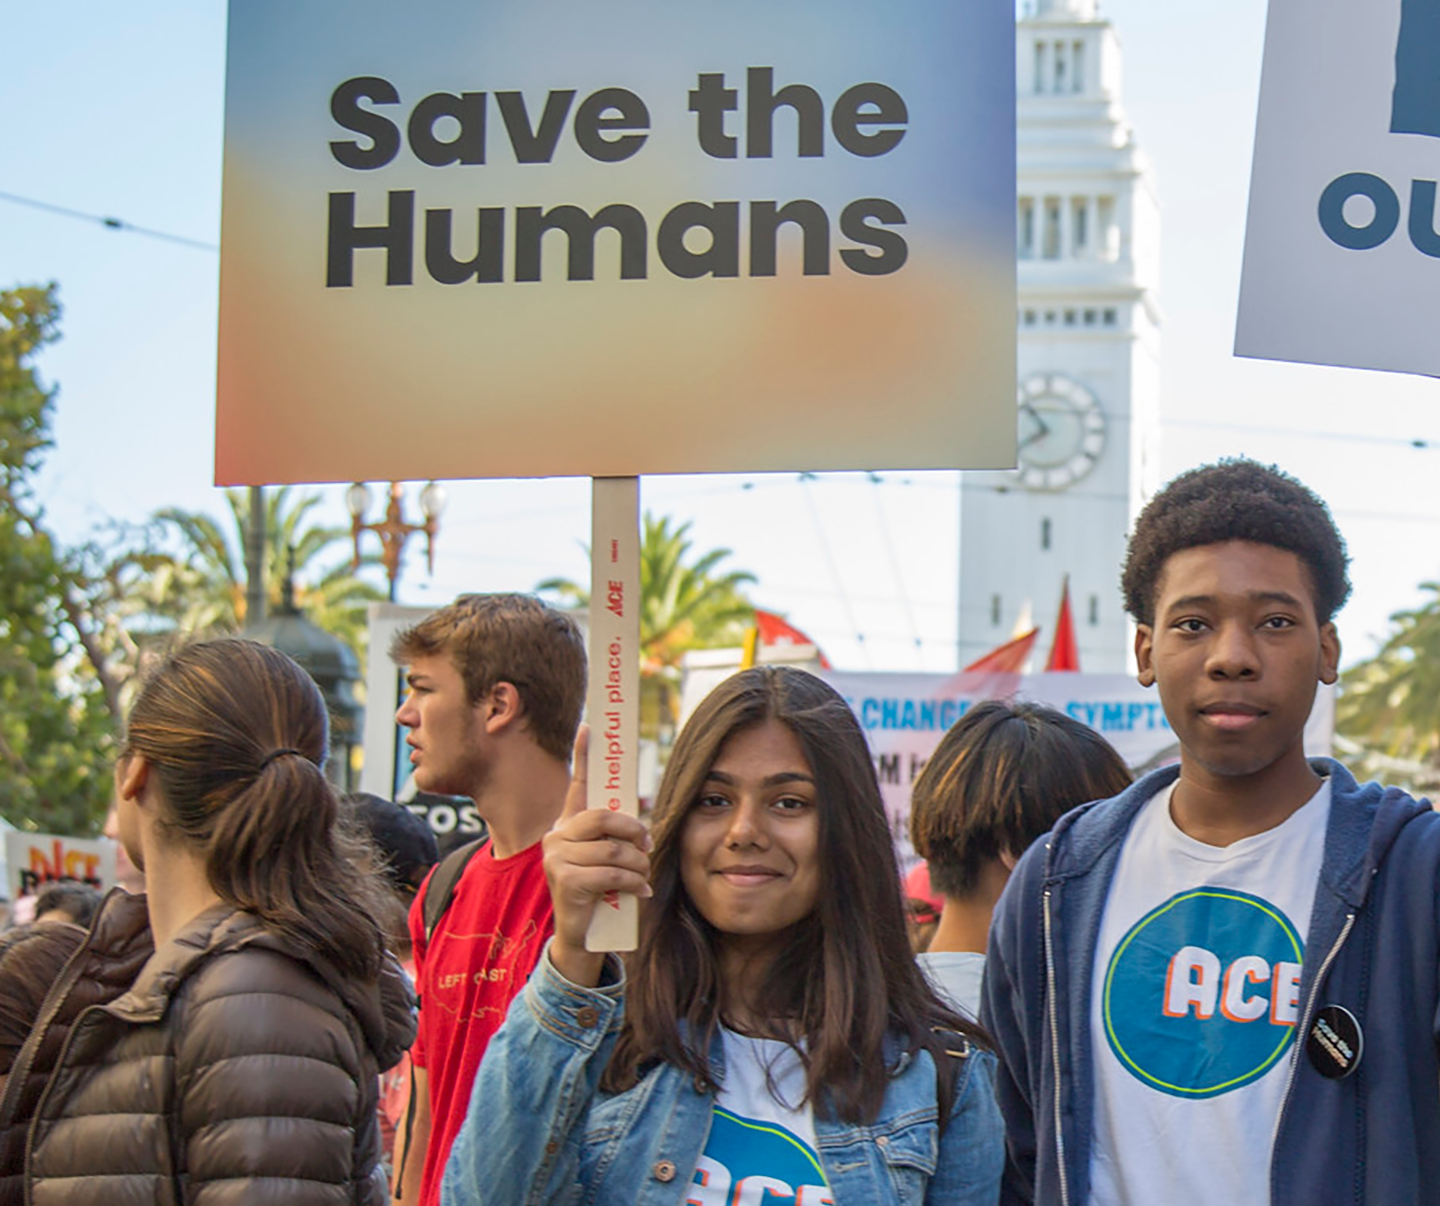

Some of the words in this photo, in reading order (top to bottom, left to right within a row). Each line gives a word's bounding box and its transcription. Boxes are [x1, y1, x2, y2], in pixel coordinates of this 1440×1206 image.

[328, 75, 650, 170] Save
[687, 67, 909, 159] the
[326, 189, 909, 288] Humans
[604, 711, 624, 790] helpful
[862, 697, 971, 731] CHANG
